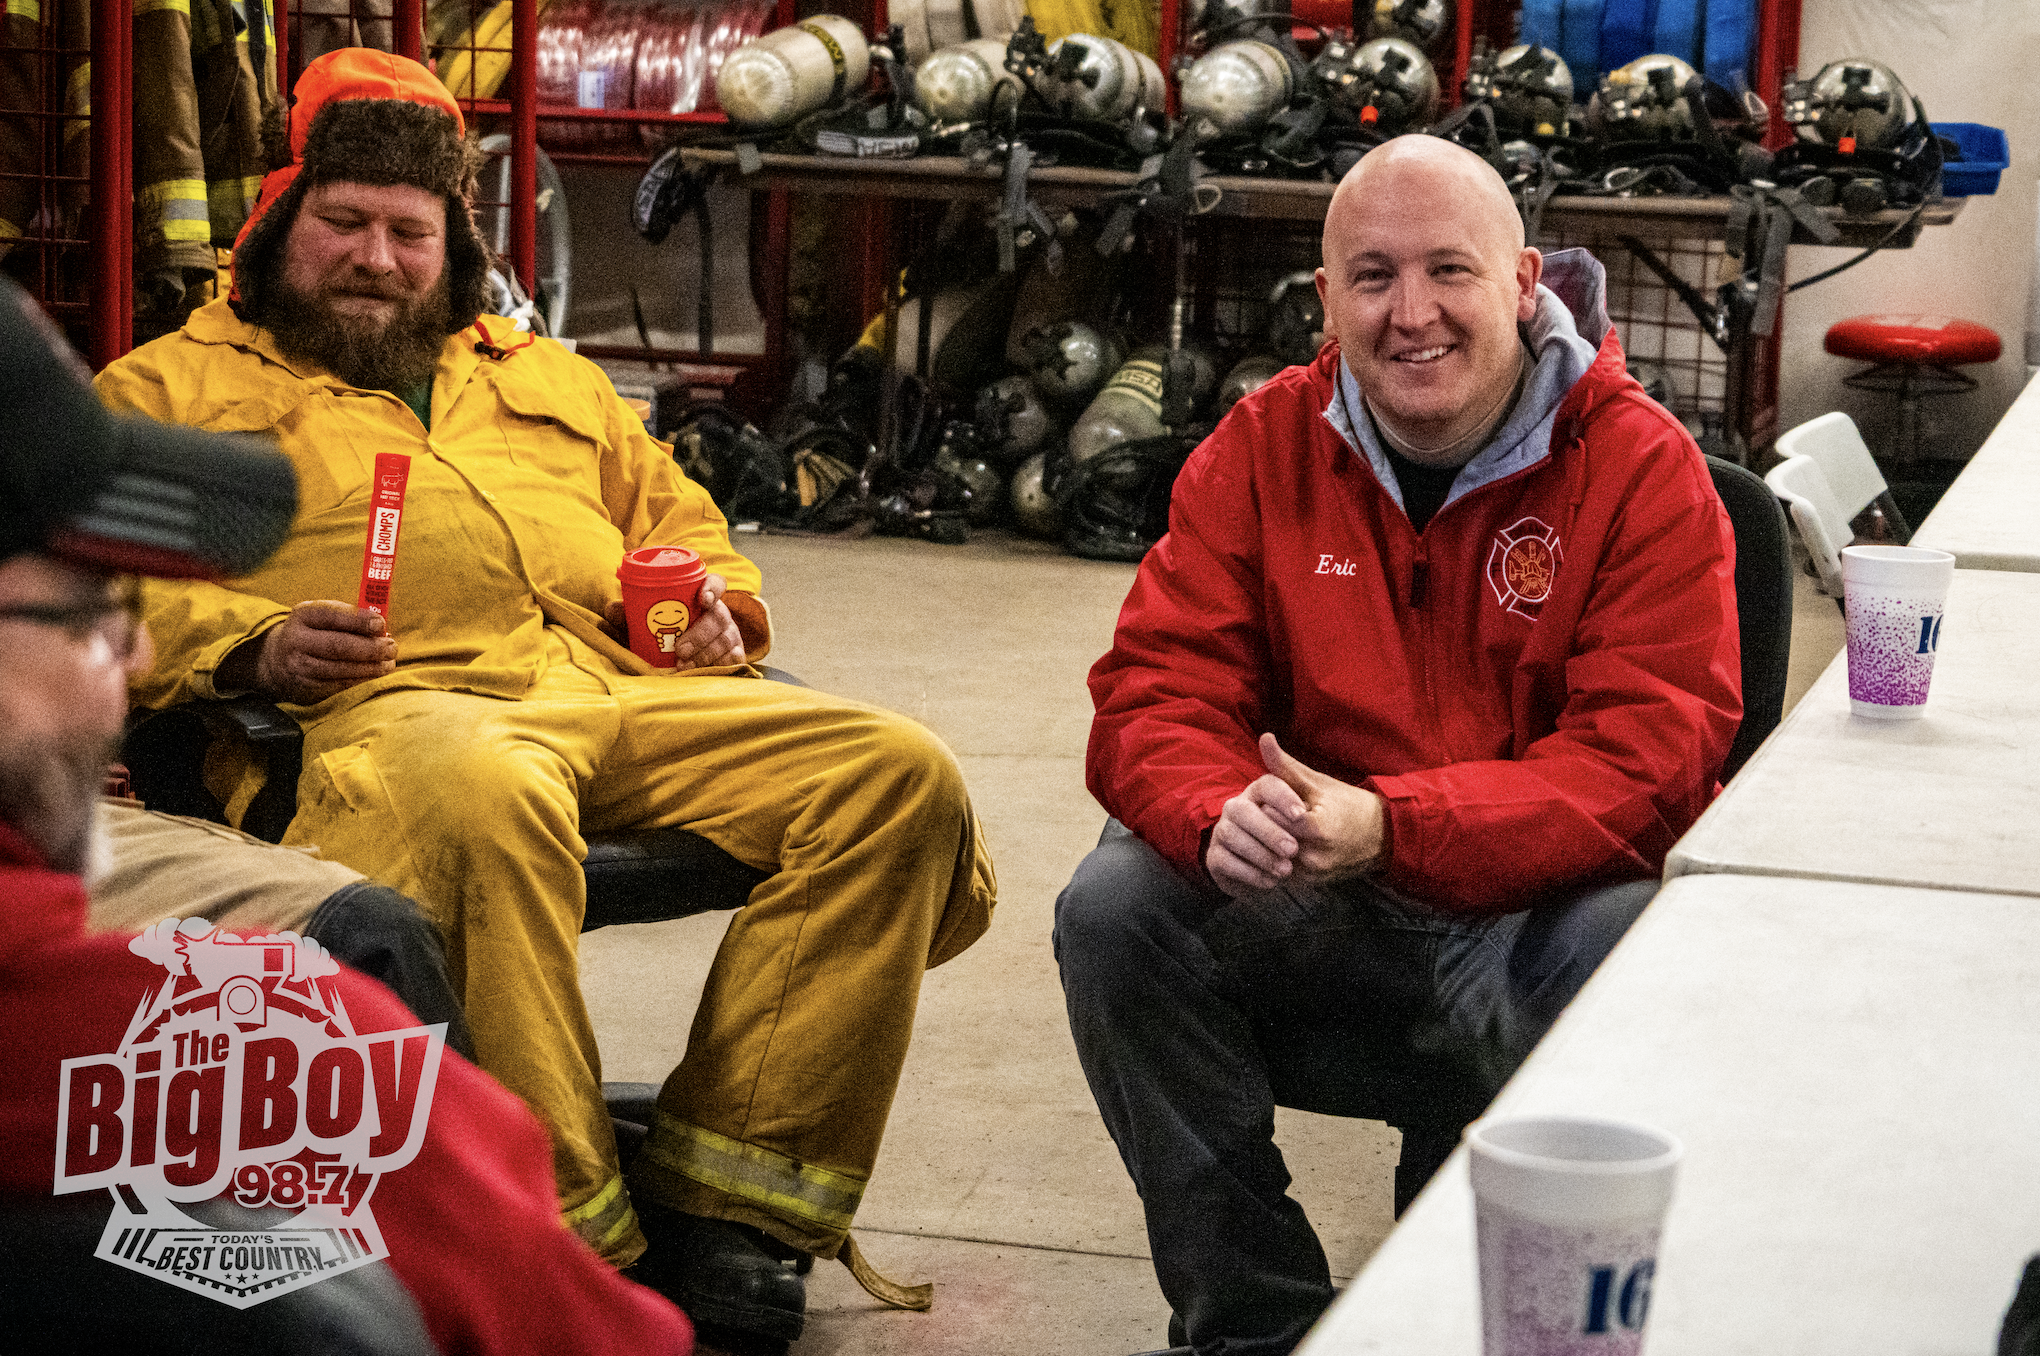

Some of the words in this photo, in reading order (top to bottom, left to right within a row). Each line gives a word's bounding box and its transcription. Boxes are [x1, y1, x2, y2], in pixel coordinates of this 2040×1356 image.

[377, 512, 395, 551] CHOMPS
[367, 568, 391, 580] BEEF
[1314, 554, 1357, 576] Eric
